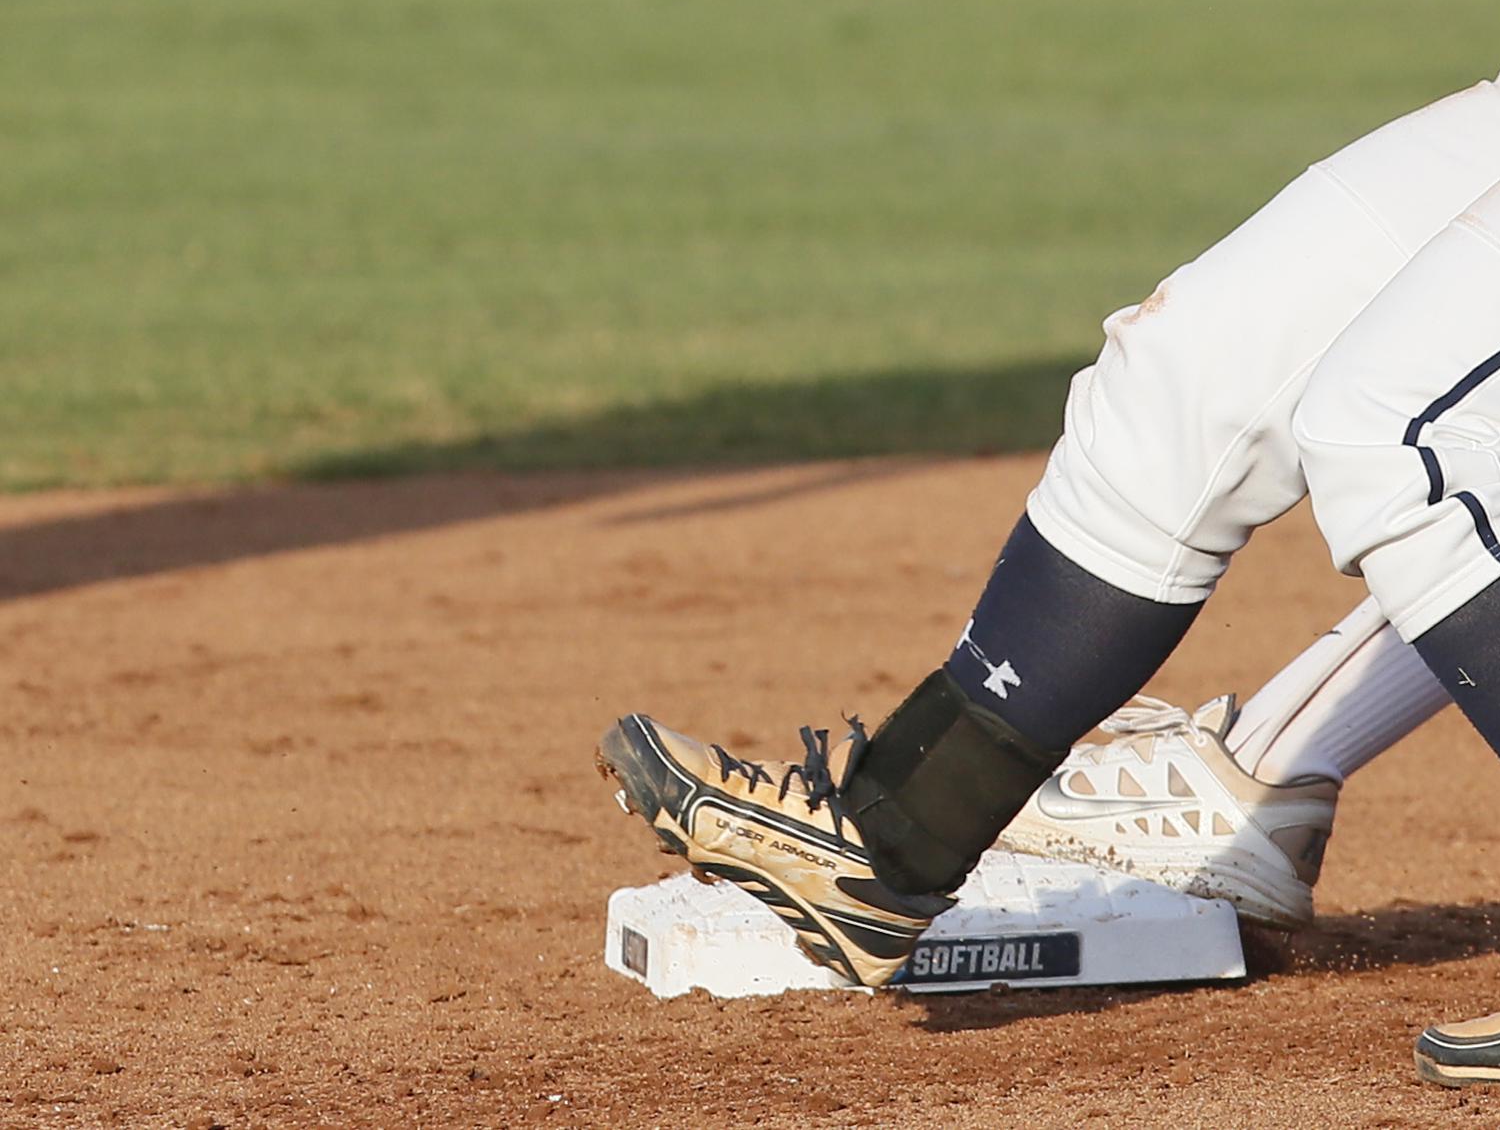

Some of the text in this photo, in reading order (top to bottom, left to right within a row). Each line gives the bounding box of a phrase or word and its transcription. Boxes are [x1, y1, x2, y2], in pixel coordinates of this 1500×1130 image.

[716, 818, 838, 870] UNDER ARMOUR
[912, 941, 1044, 976] SOFTBALL
